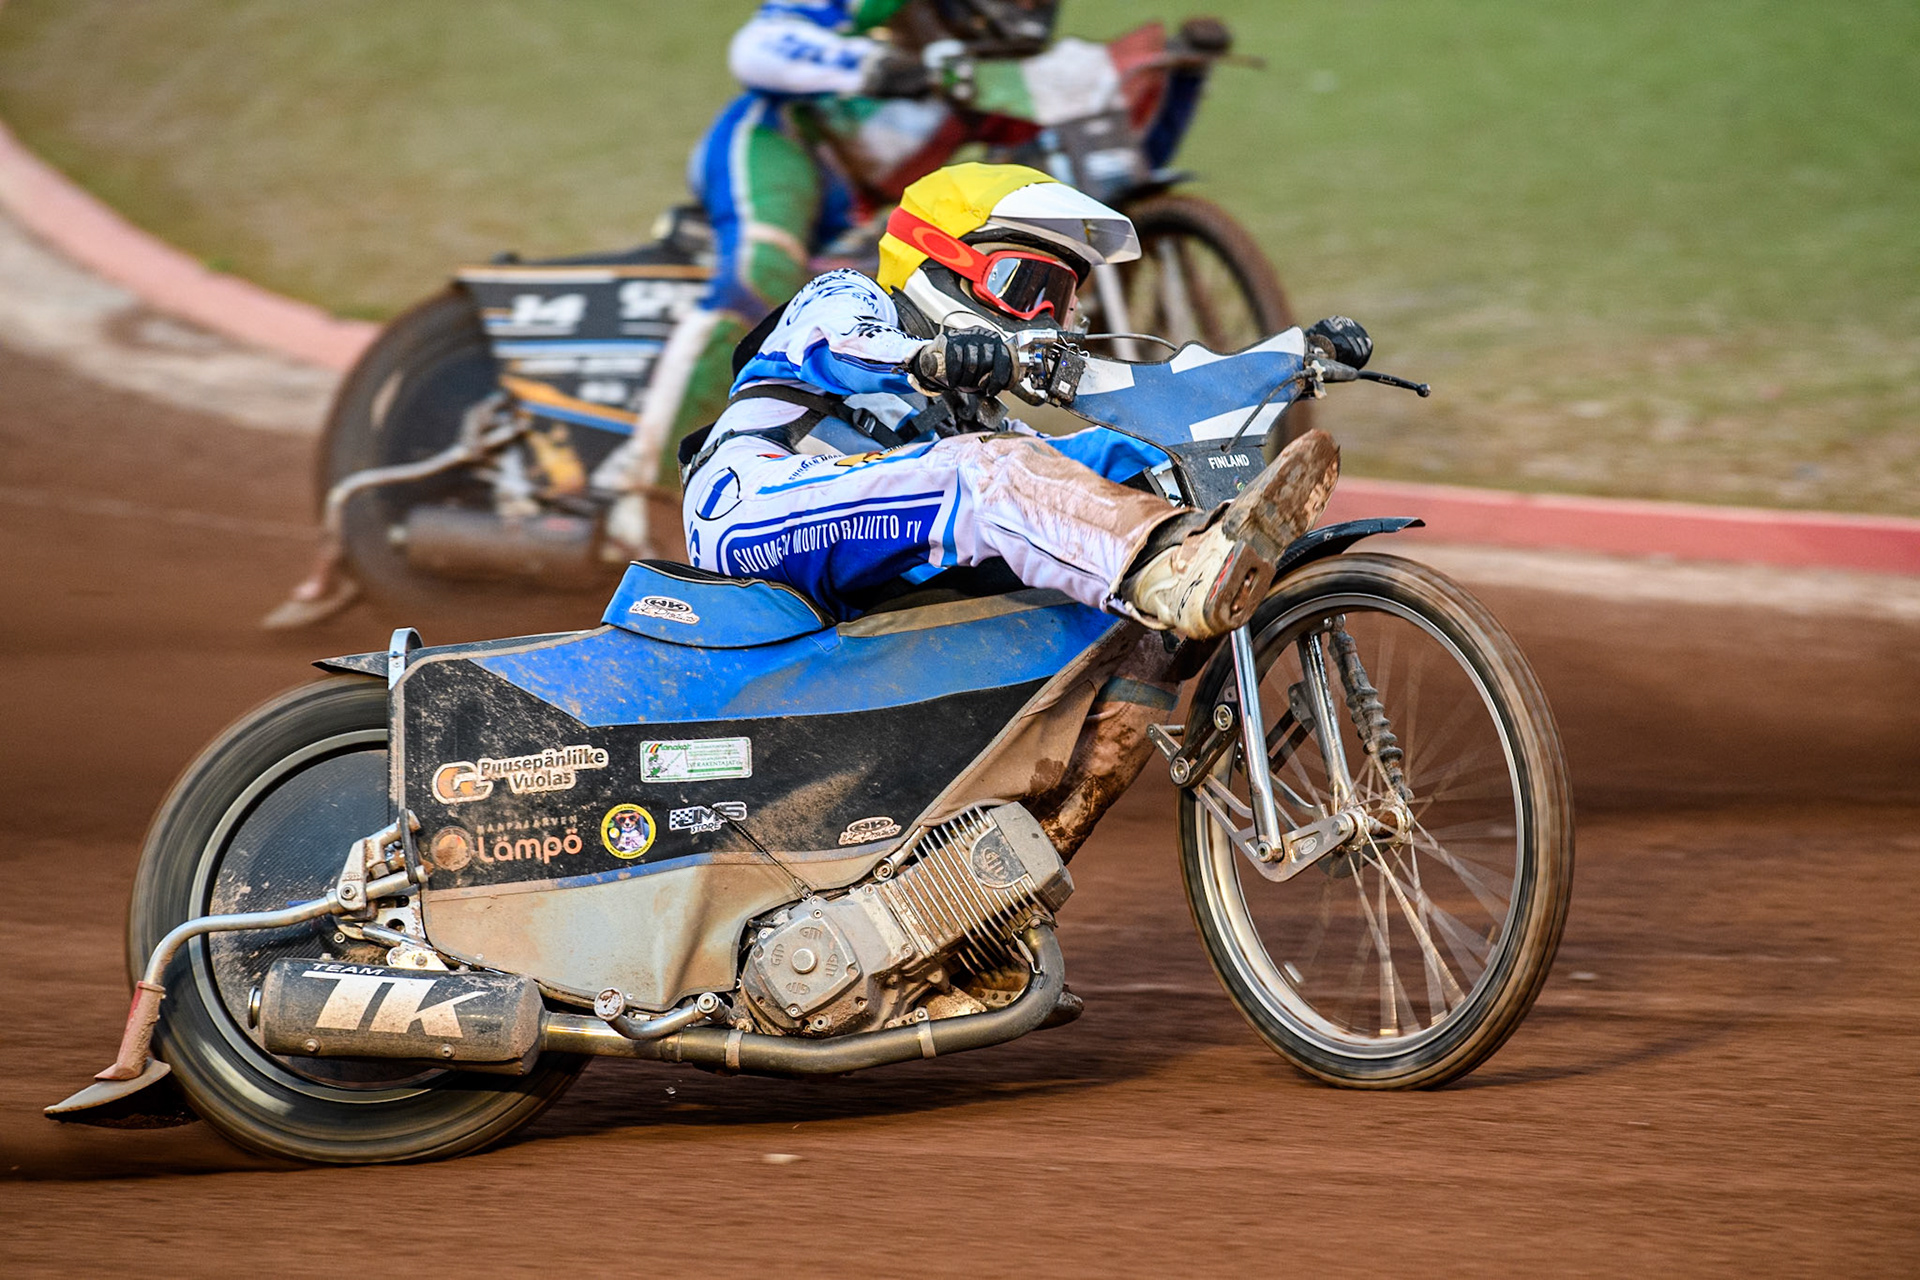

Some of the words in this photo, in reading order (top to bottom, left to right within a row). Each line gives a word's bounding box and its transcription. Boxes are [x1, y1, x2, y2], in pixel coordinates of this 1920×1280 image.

[1207, 453, 1250, 470] FINLAND
[906, 520, 922, 543] ry
[480, 748, 605, 777] Puusepänliike
[511, 769, 572, 790] Vuolas
[691, 821, 721, 833] STORE
[478, 828, 583, 865] Lämpö
[313, 963, 385, 976] TEAM
